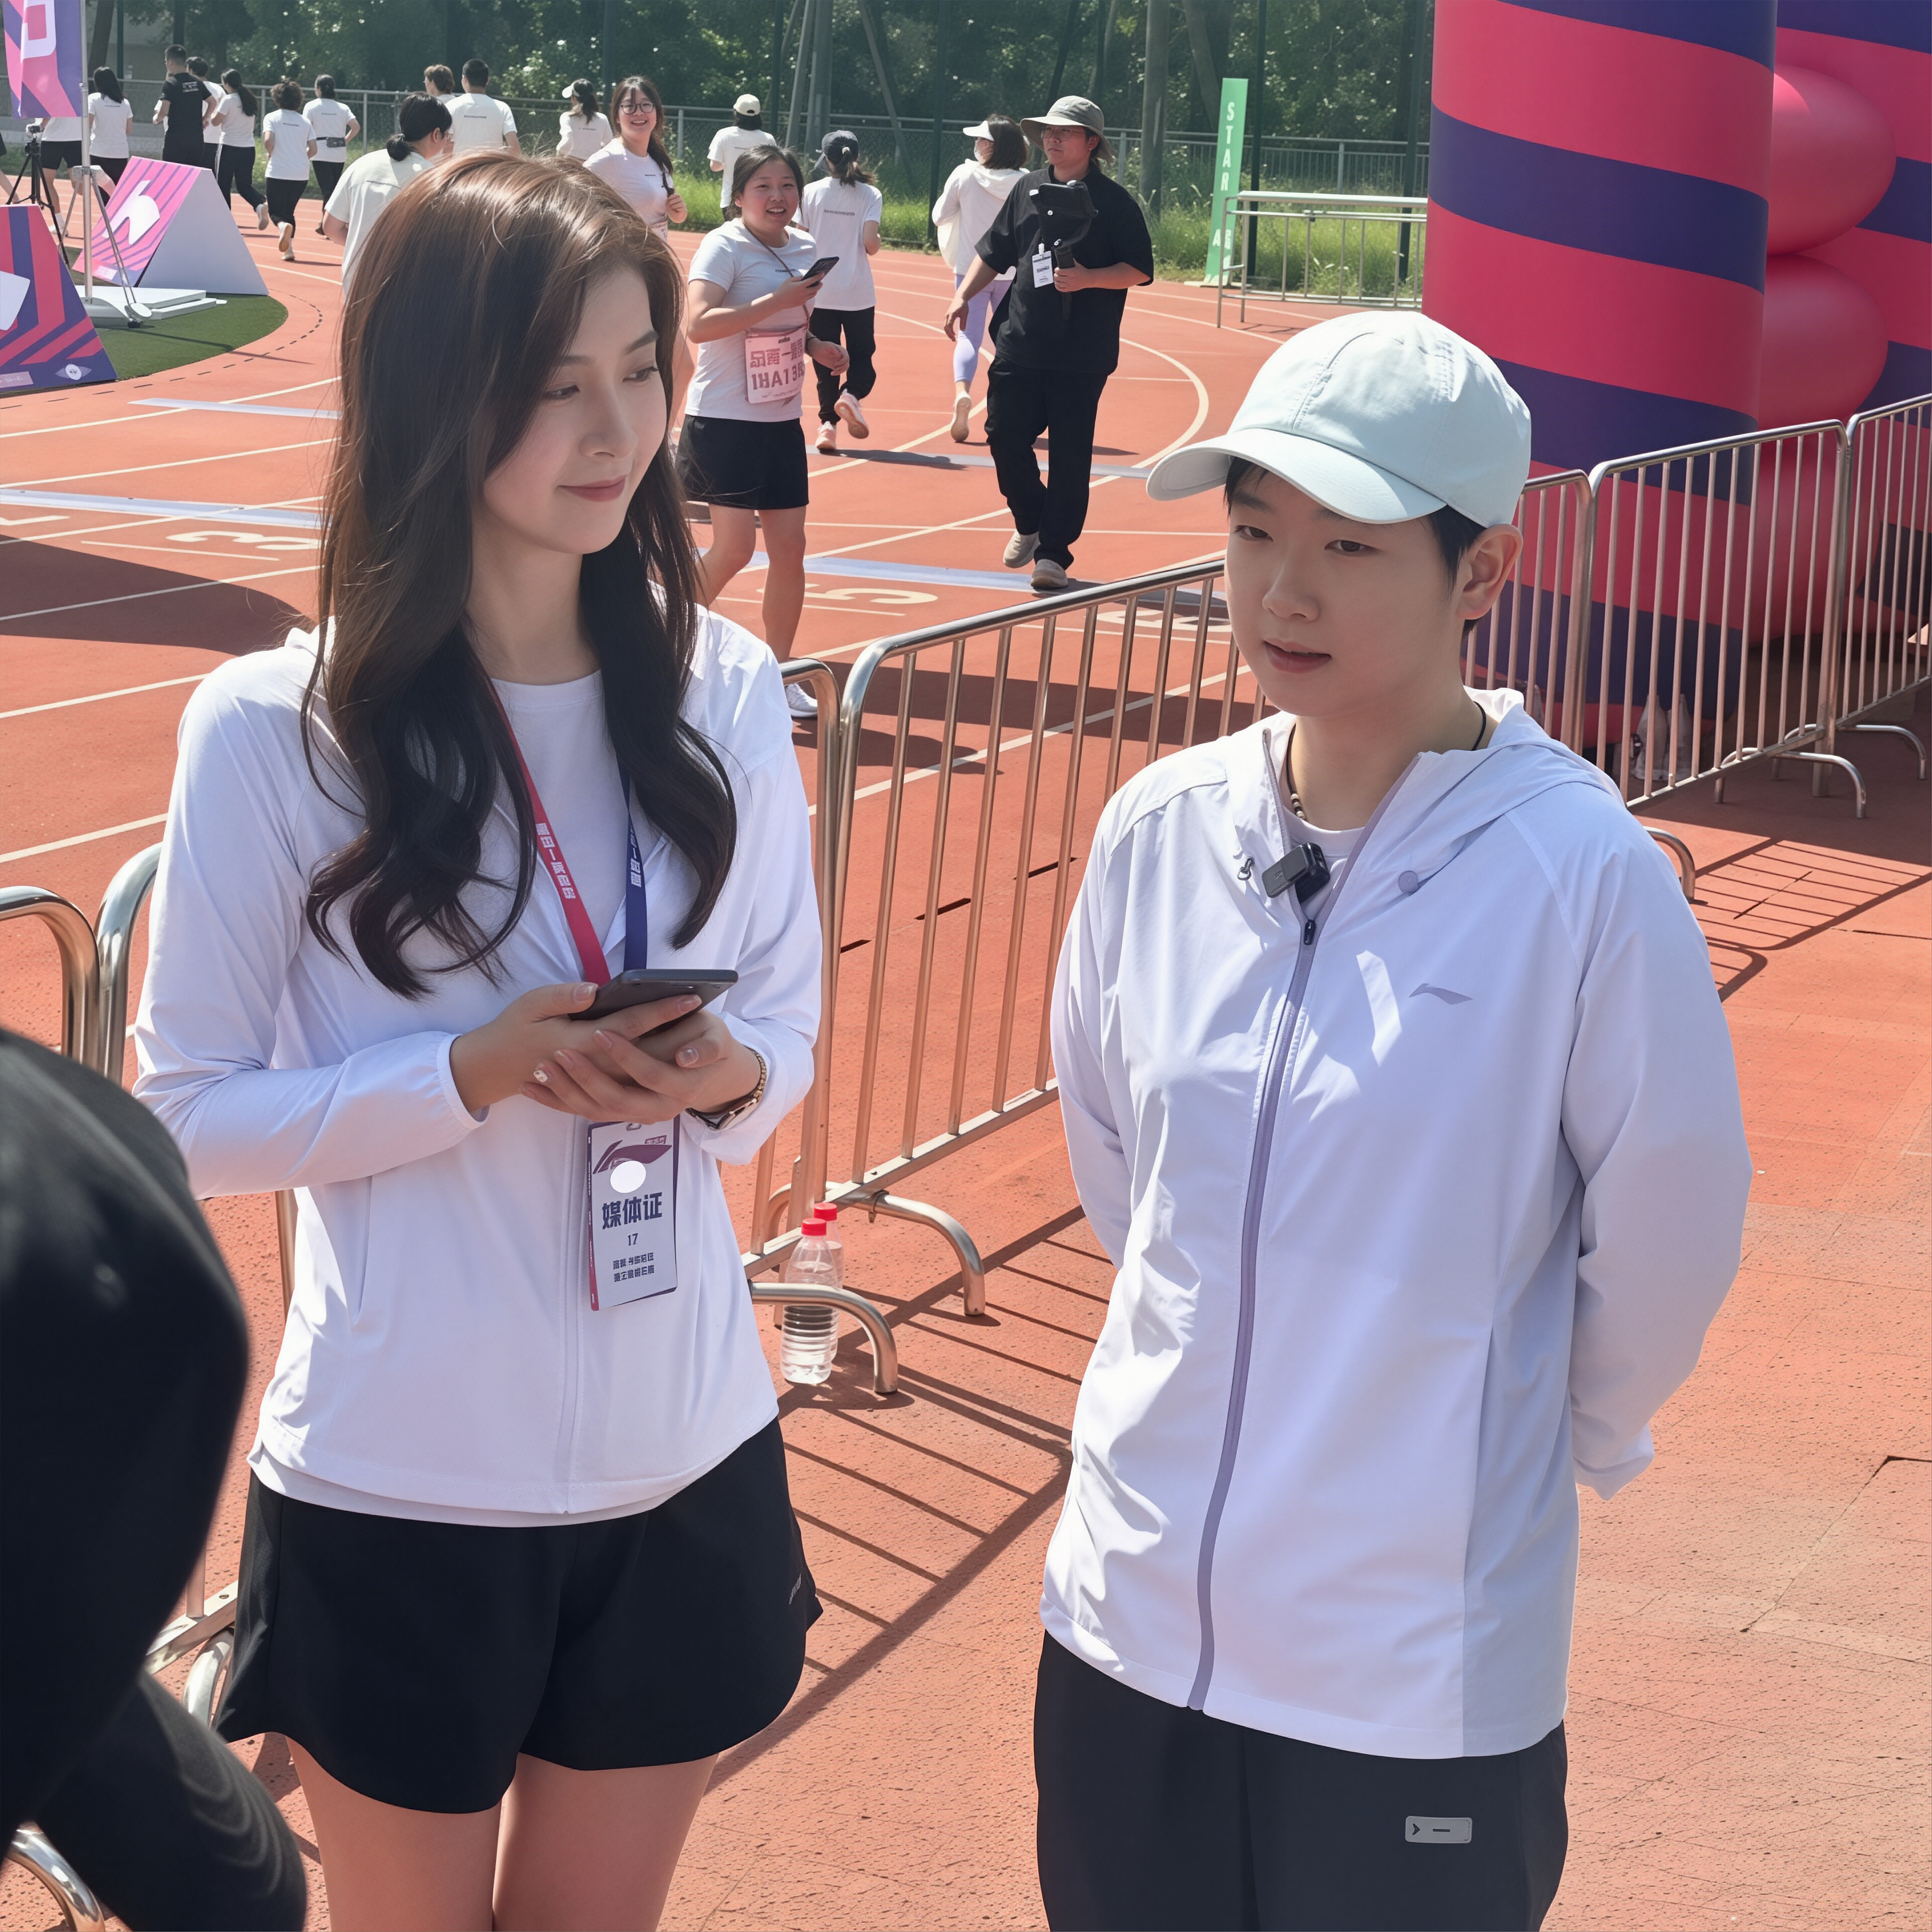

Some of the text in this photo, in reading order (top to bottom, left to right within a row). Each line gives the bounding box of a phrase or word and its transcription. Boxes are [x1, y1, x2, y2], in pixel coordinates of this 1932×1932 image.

[602, 1192, 662, 1230] 媒体证
[628, 1233, 638, 1246] 17
